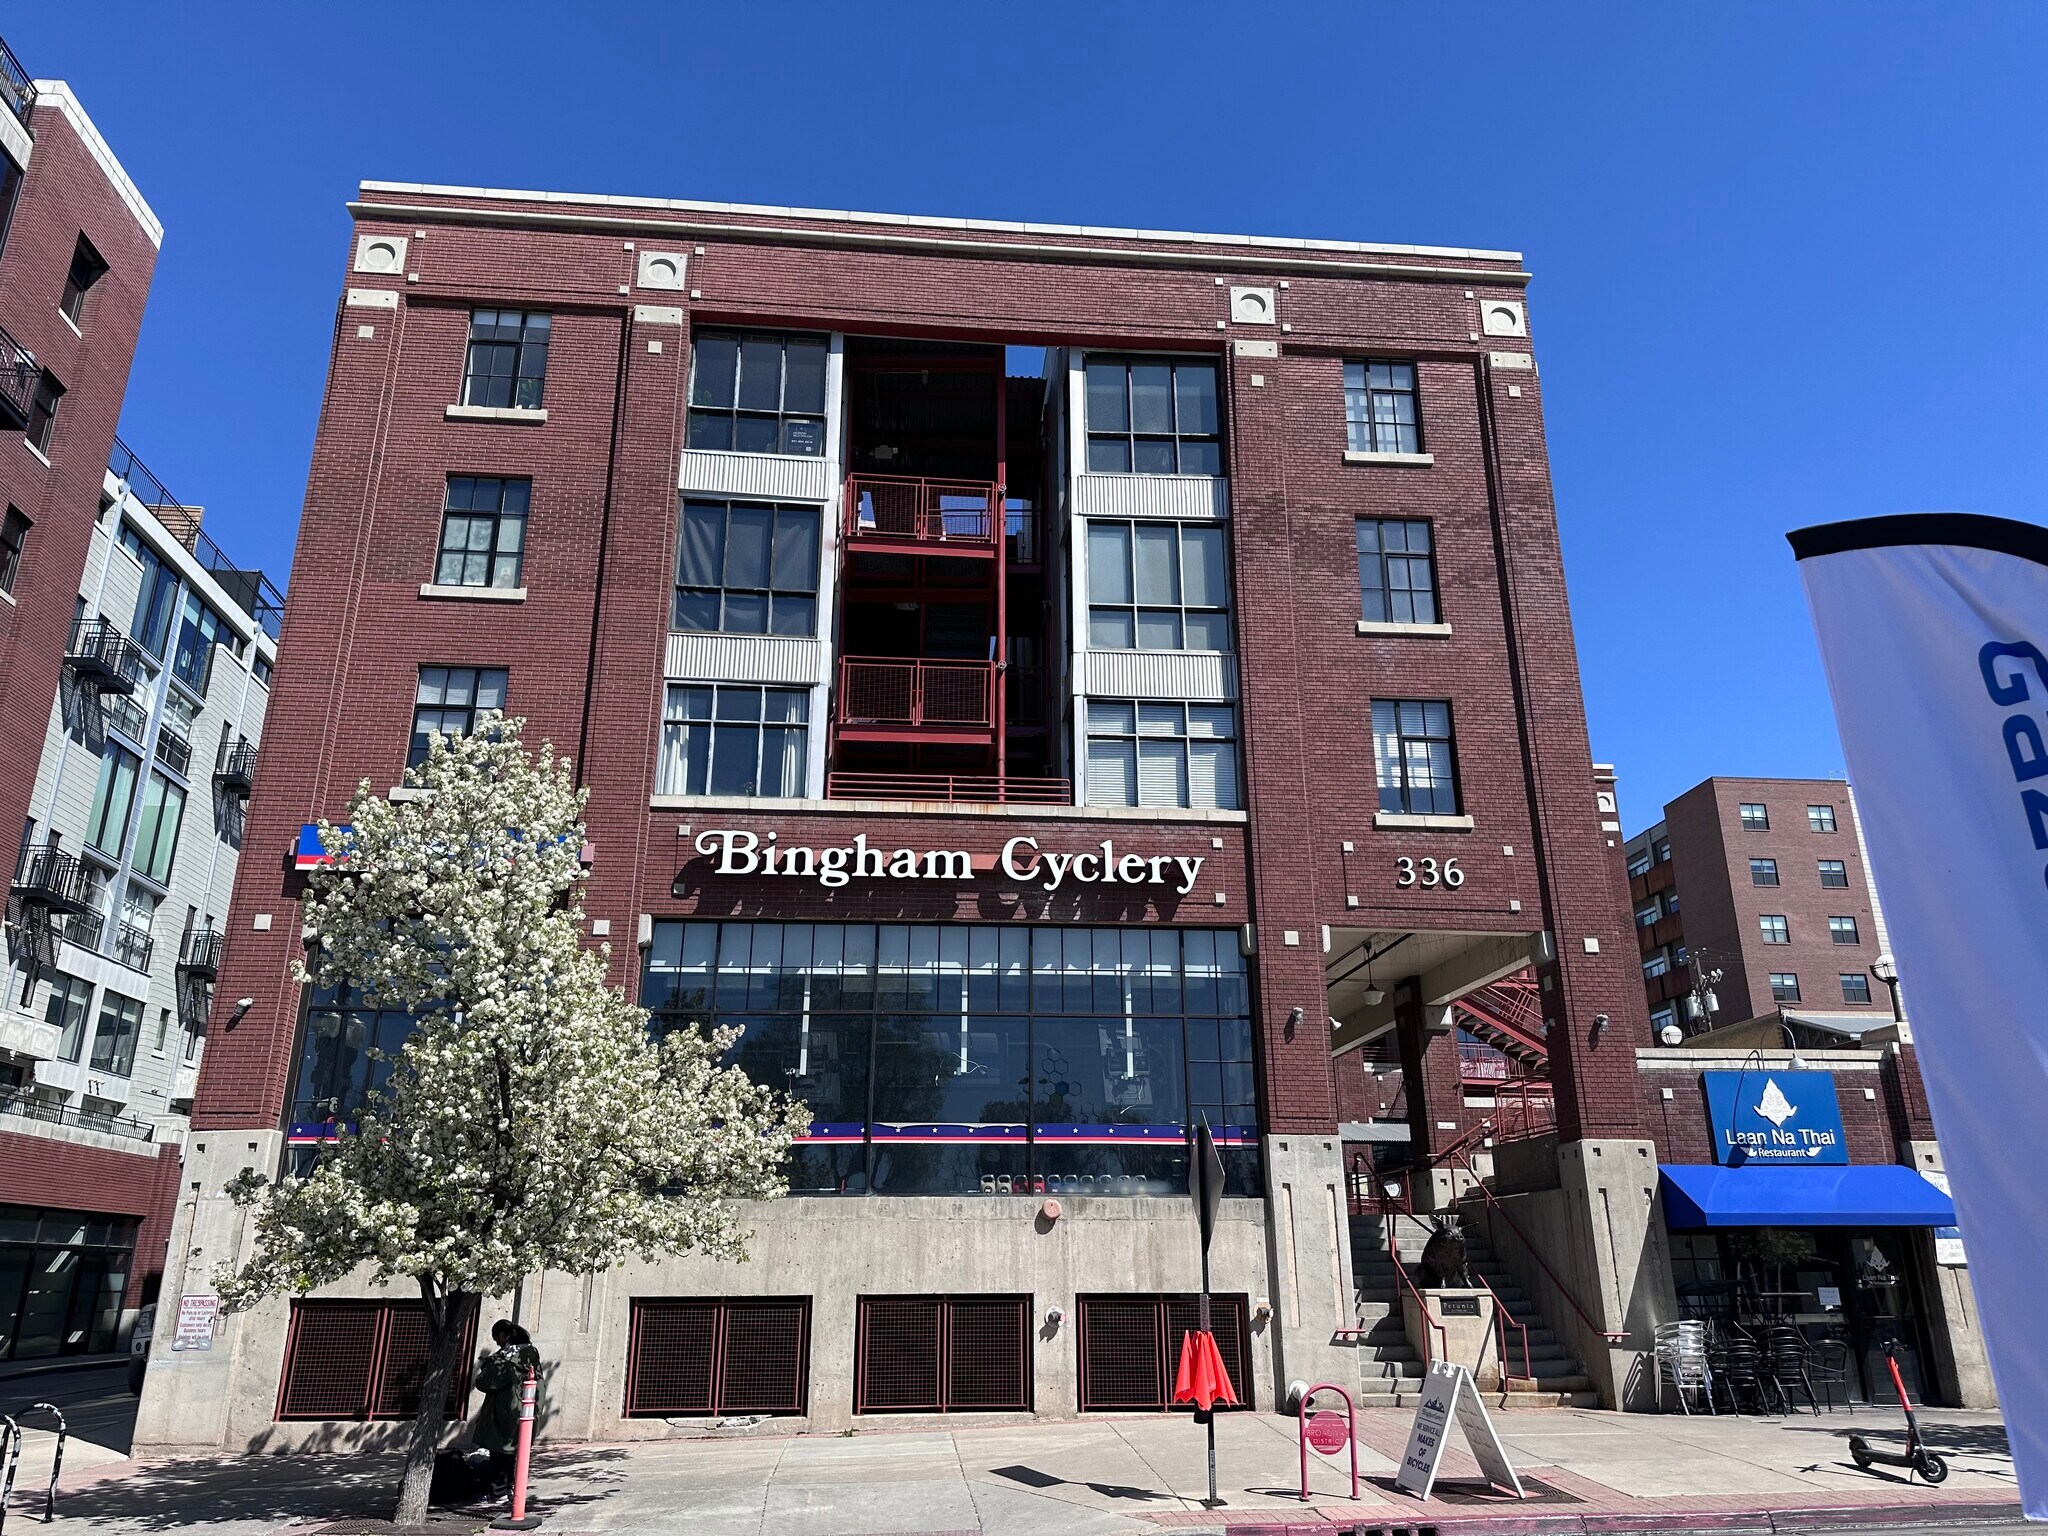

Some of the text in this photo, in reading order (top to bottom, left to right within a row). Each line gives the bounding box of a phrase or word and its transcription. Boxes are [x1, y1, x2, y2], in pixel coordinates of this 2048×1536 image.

[1979, 640, 2048, 893] Gaz
[695, 830, 1205, 894] Bingham Cyclery
[1397, 856, 1465, 886] 336
[1725, 1128, 1835, 1145] Laan Na Thai
[1758, 1148, 1807, 1157] Restaurant
[1417, 1434, 1435, 1447] MAKES
[1418, 1447, 1427, 1457] OF
[1407, 1457, 1430, 1473] BICYCLES
